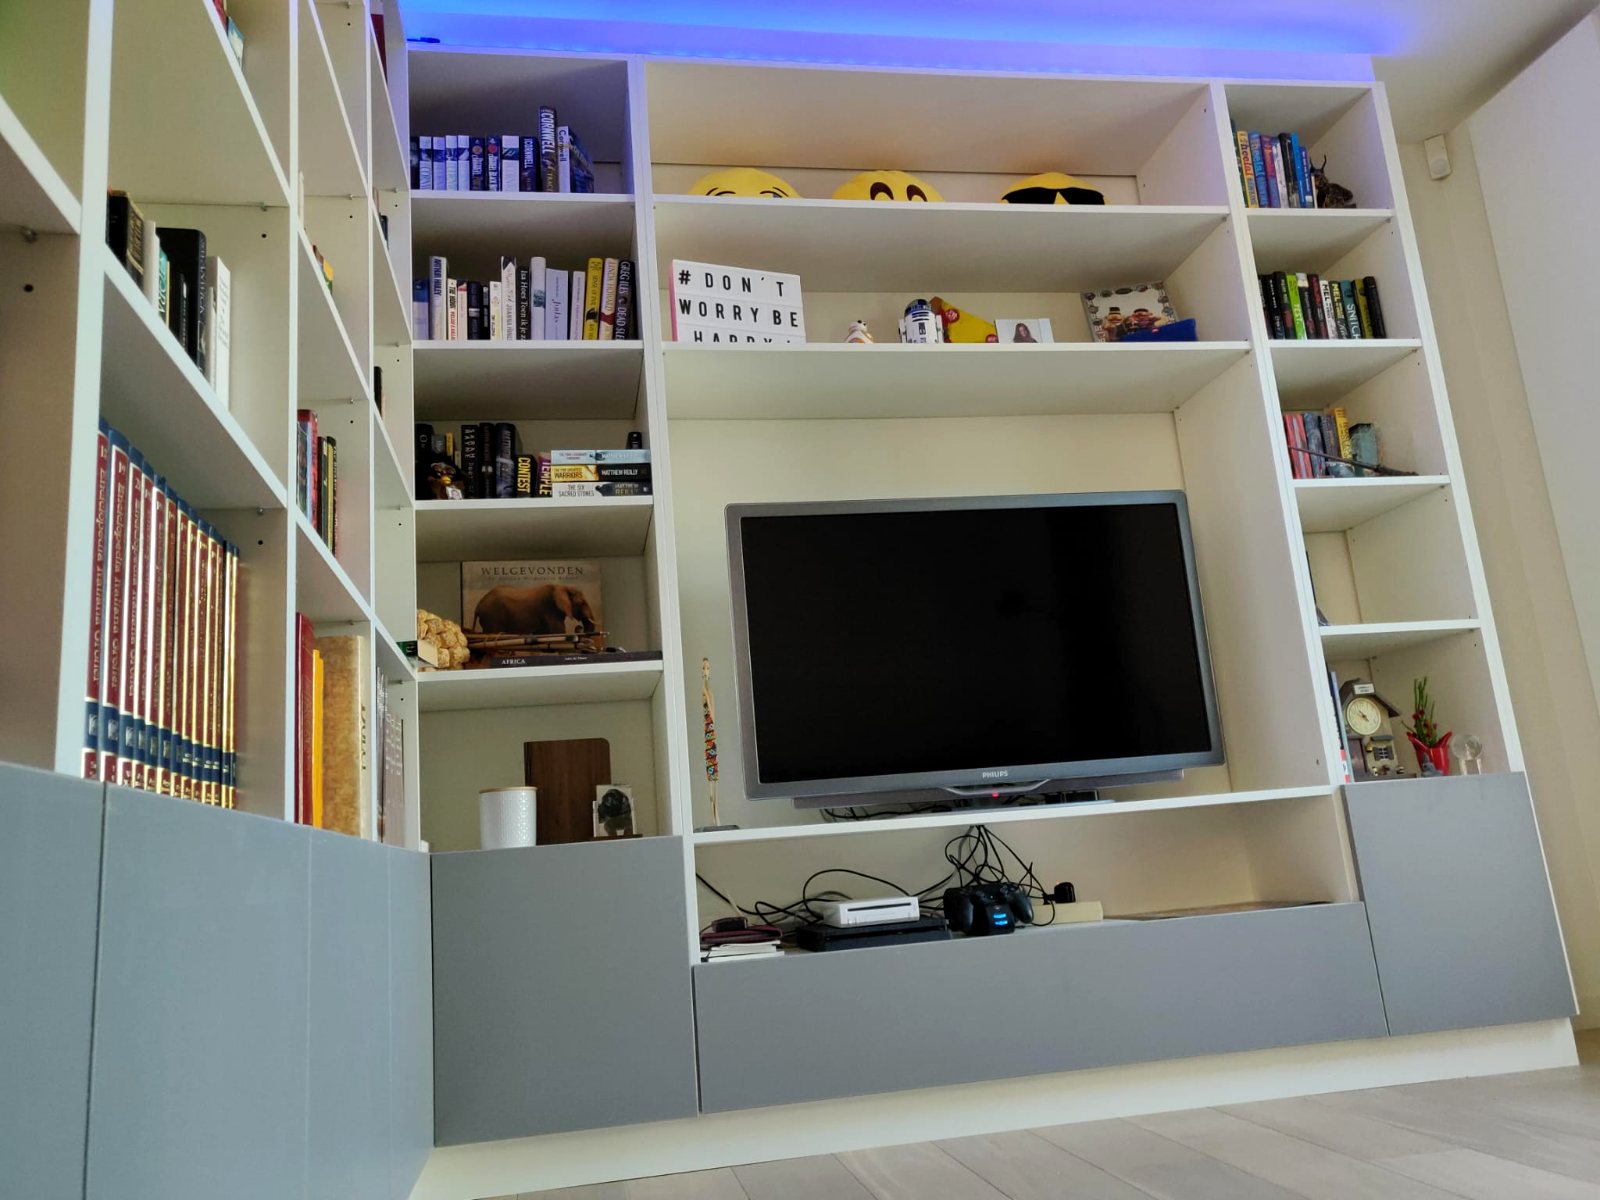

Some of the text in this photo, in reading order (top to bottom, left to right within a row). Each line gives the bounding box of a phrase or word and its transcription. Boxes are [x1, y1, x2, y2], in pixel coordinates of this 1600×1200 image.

[541, 112, 555, 154] CORNWELL
[559, 129, 567, 162] Cornwell
[618, 261, 631, 294] GREG ILES
[520, 281, 528, 299] Hoes
[1322, 283, 1330, 302] MEL
[1332, 283, 1341, 304] MEL
[520, 301, 528, 317] Toen
[616, 307, 628, 327] DEAD
[678, 298, 798, 327] WORRY BE
[517, 457, 531, 493] CONTEST
[539, 460, 552, 496] TEMPLE
[554, 472, 583, 480] WARRIORS
[601, 468, 638, 476] MATTHEW REILLY
[114, 482, 125, 573] Enciclopedia
[481, 565, 584, 576] WELGEVONDEN
[113, 576, 122, 633] Italiana
[982, 770, 1008, 778] PHILIPS
